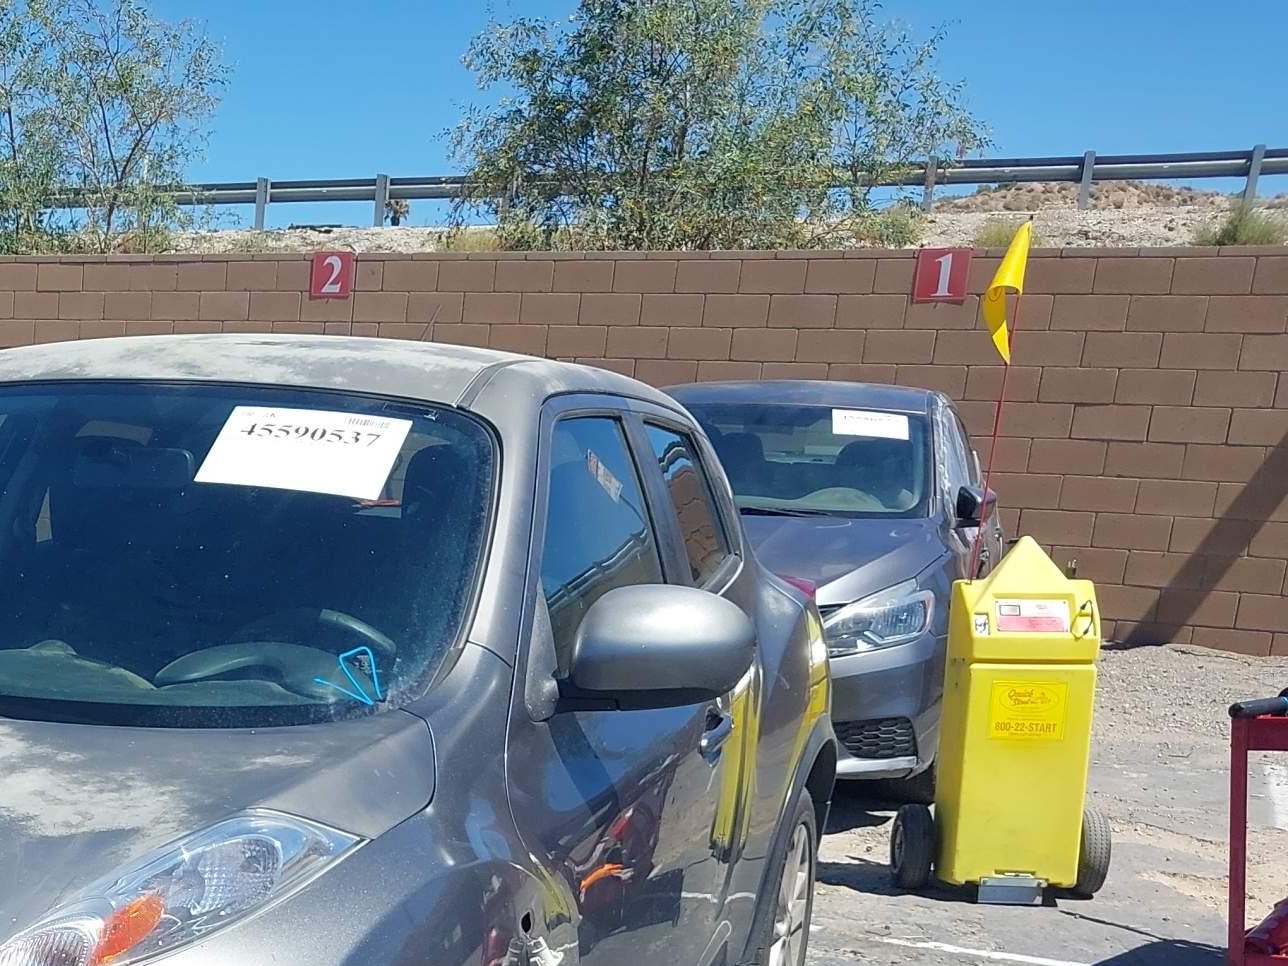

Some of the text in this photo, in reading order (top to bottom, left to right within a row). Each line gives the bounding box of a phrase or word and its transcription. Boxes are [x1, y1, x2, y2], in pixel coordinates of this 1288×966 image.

[320, 255, 342, 293] 2
[930, 252, 953, 297] 1
[240, 422, 382, 447] 45590537
[994, 721, 1057, 734] 800-22-START
